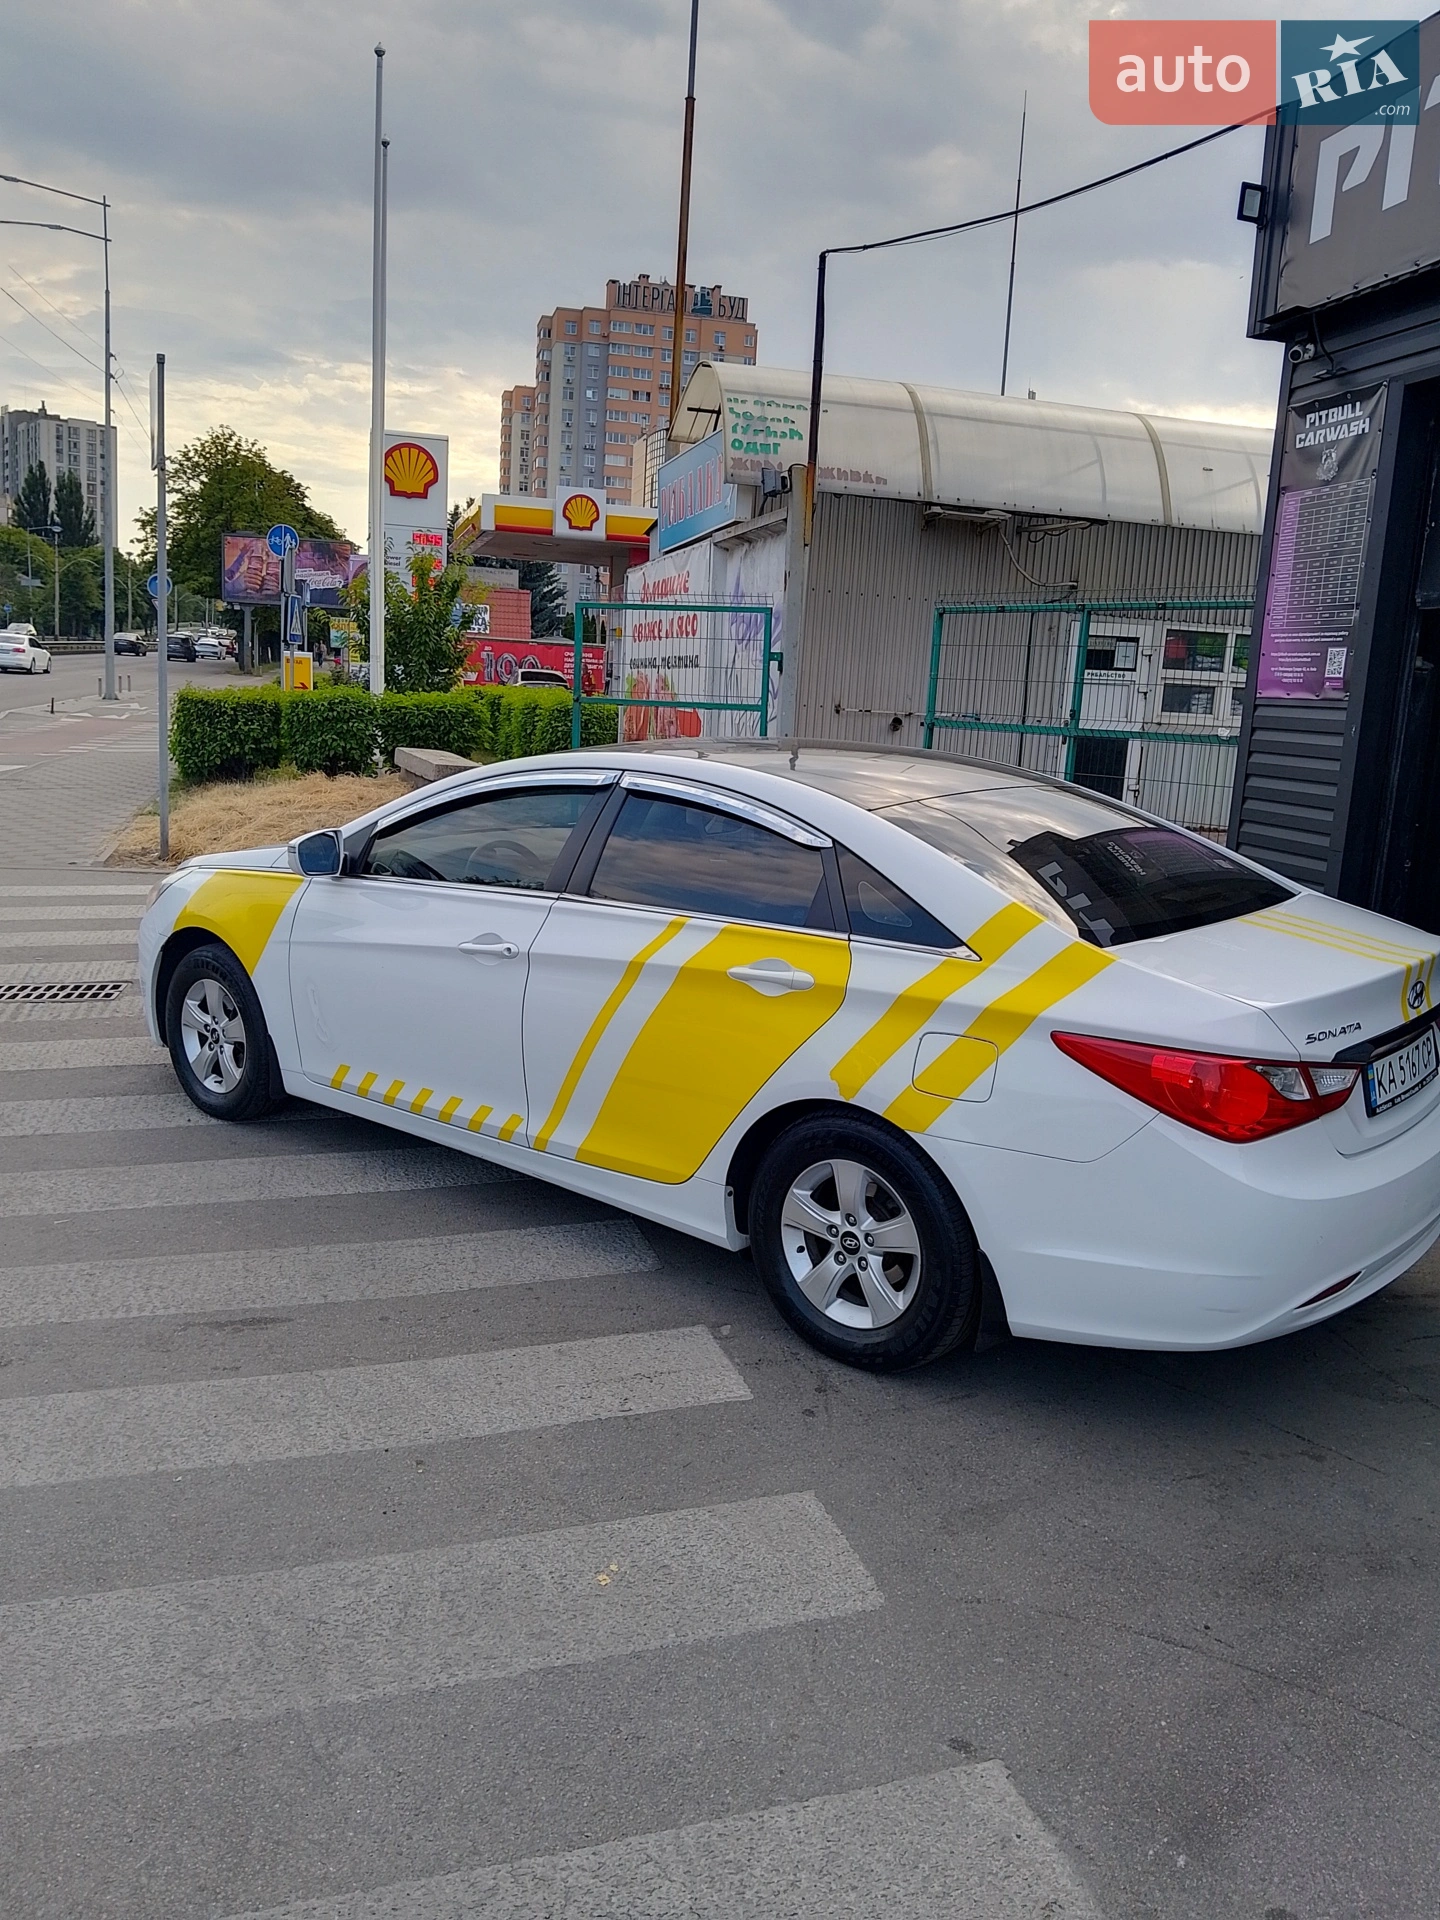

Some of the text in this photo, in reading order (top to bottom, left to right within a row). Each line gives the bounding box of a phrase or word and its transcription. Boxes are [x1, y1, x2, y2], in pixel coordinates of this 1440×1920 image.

[1305, 401, 1363, 429] PITBULL
[1295, 417, 1370, 449] CARWASH
[1305, 1022, 1362, 1045] SONATA
[1398, 1044, 1420, 1086] 5167
[1421, 1036, 1433, 1070] CP
